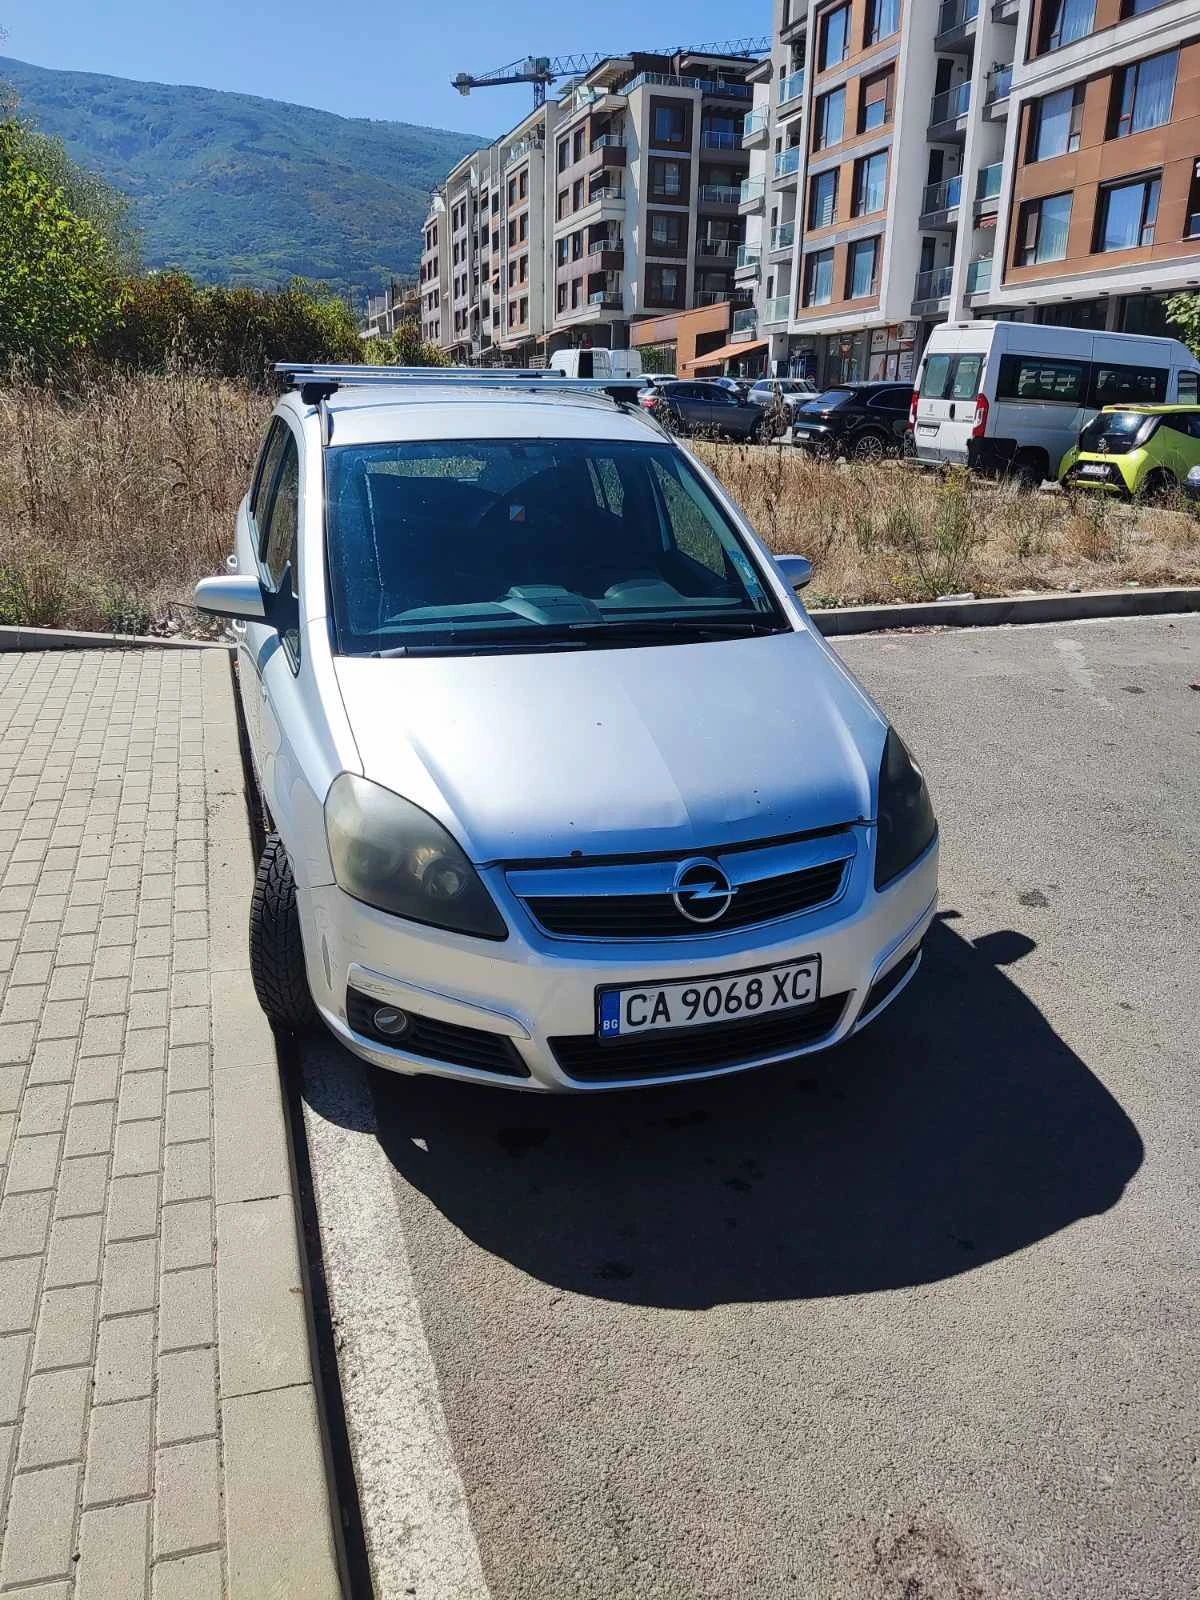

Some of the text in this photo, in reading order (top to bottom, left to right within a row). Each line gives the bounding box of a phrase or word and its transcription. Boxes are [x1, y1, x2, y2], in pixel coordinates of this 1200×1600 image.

[626, 968, 811, 1026] CA 9068 XC
[603, 1019, 618, 1030] BG
